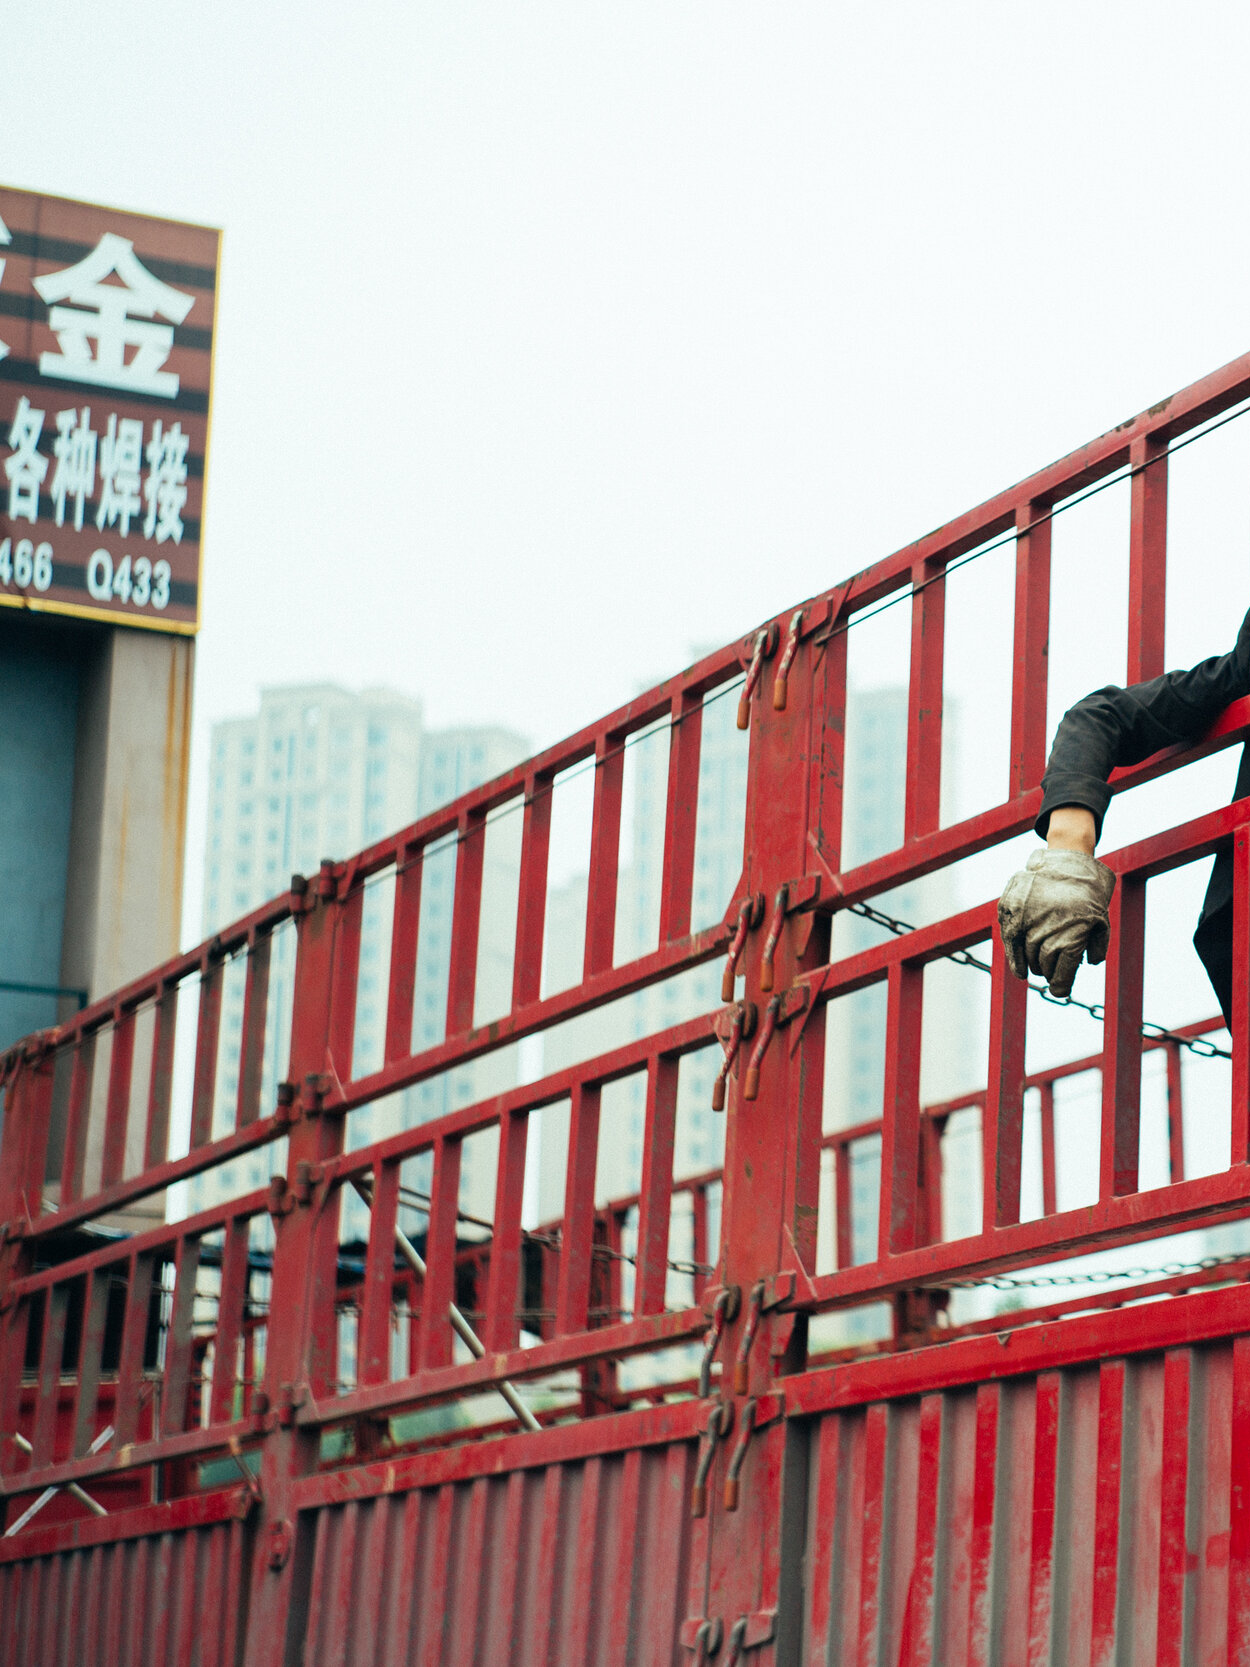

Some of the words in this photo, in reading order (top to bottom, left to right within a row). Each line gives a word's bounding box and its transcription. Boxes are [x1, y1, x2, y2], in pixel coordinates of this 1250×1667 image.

[0, 215, 196, 399] 金
[4, 395, 190, 545] 各种焊接
[87, 548, 171, 610] Q433
